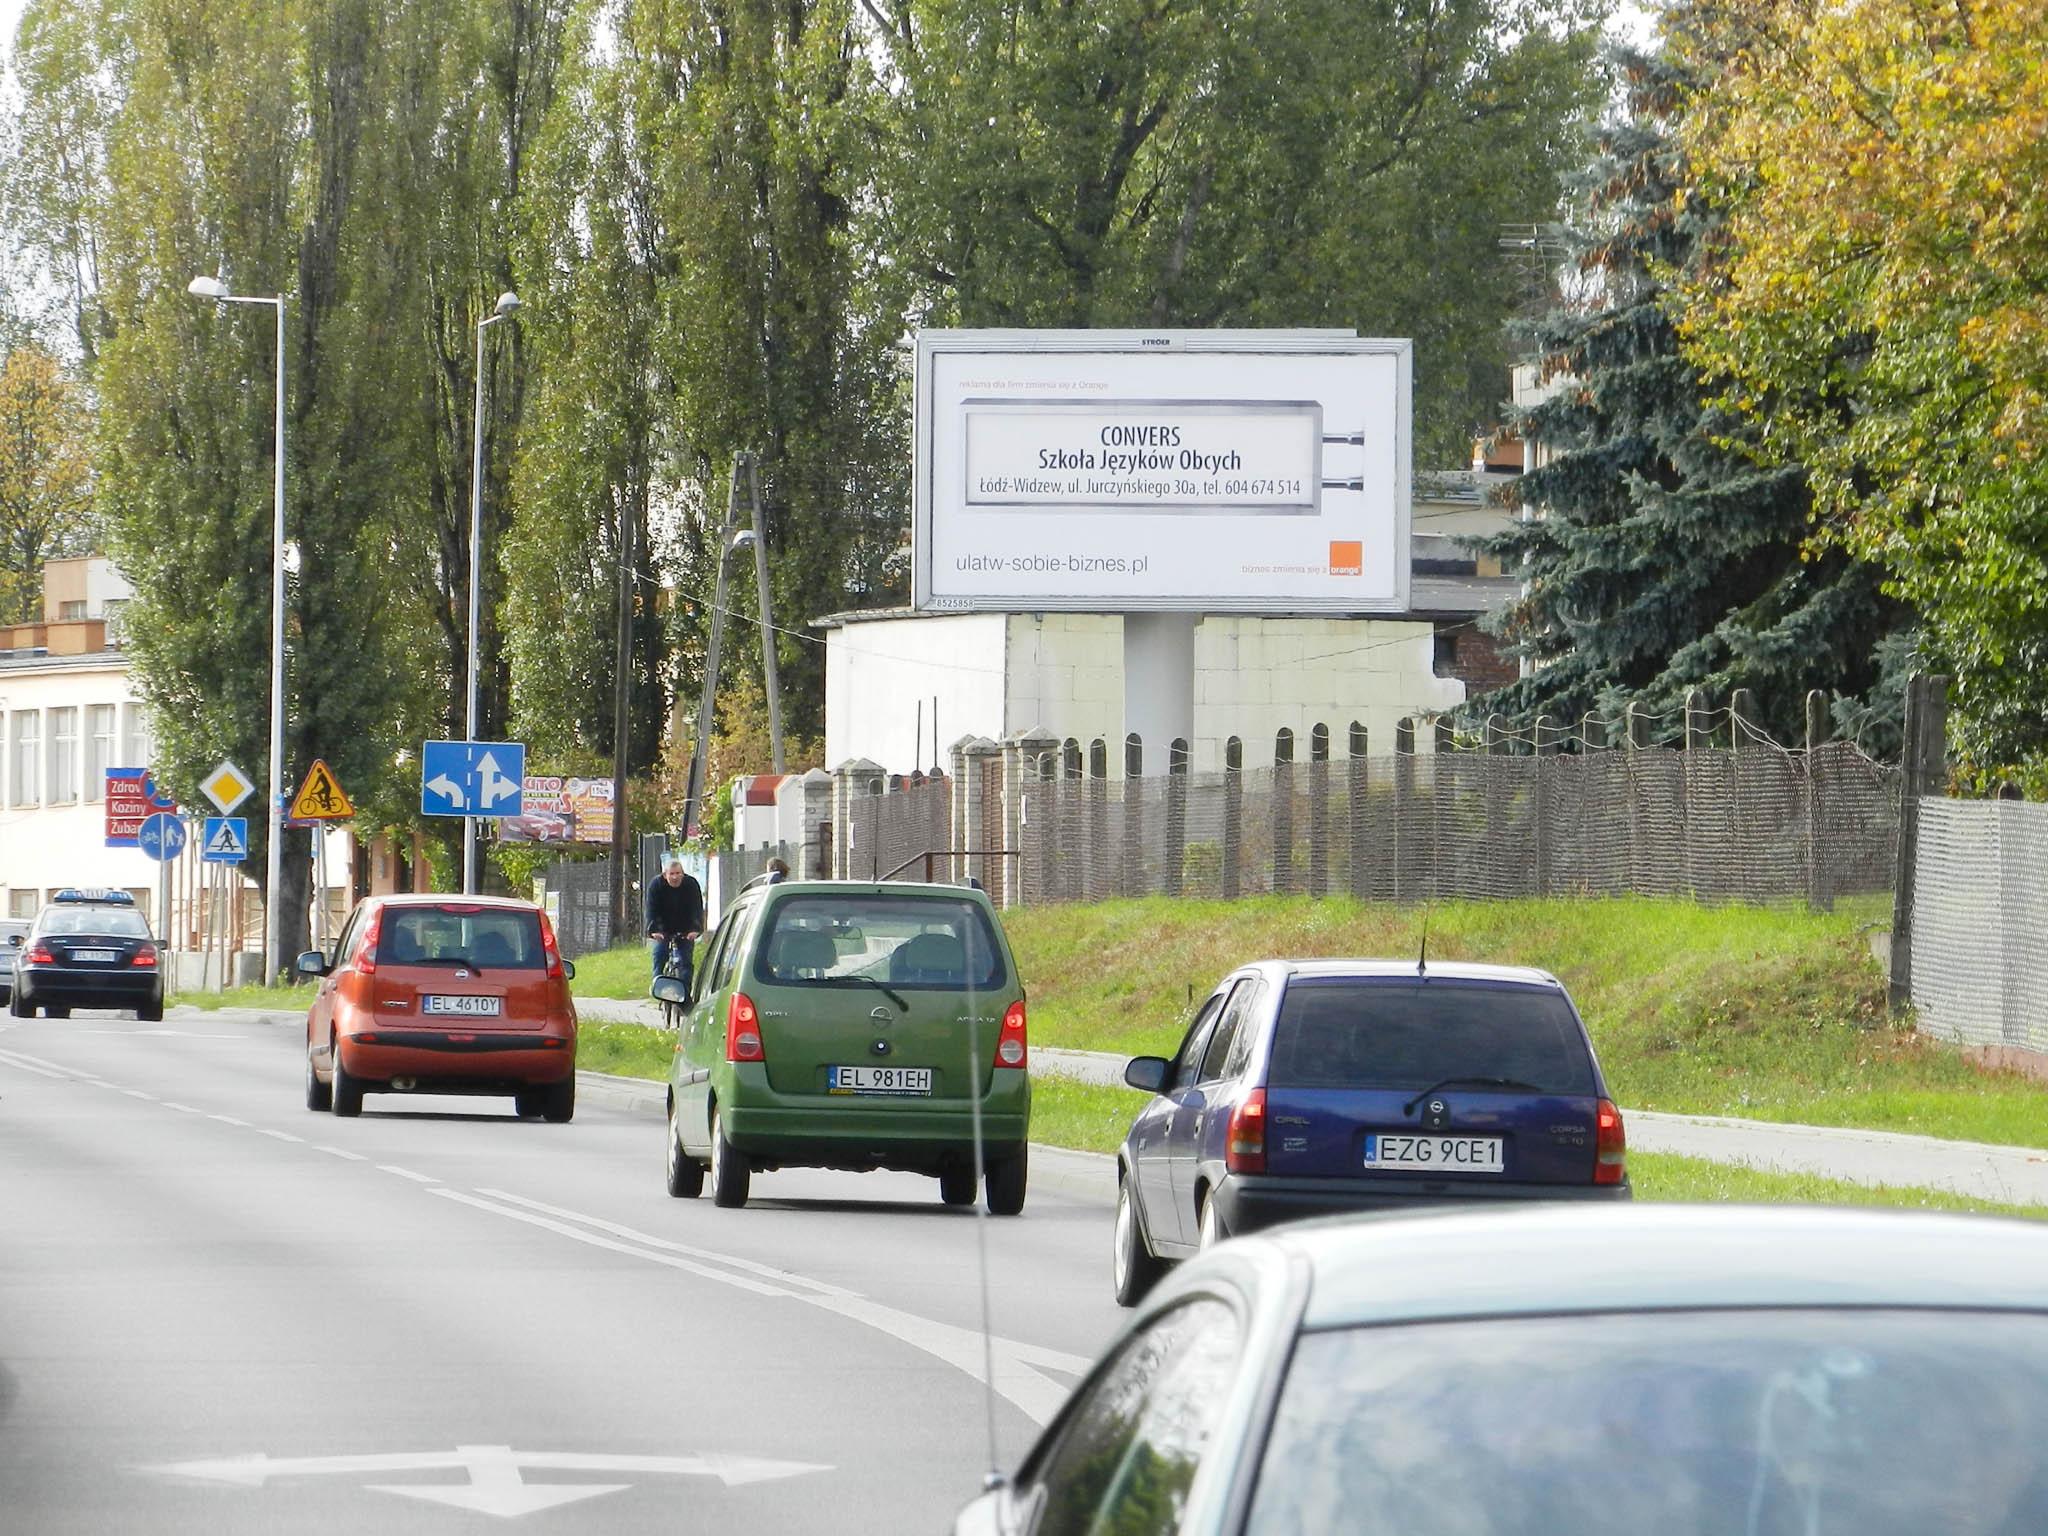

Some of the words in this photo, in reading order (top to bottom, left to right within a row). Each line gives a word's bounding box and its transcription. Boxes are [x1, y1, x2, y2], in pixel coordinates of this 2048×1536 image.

[1101, 425, 1181, 447] CONVERS
[1039, 448, 1095, 470] Szkoła
[1100, 449, 1174, 476] Języków
[1179, 449, 1242, 476] Obcych
[979, 476, 1064, 495] Łódź-Widzew,
[1068, 477, 1082, 494] ul.
[1086, 478, 1170, 498] Jurczyńskiego
[1174, 479, 1200, 497] 30a,
[1203, 480, 1222, 495] tel.
[1225, 479, 1248, 495] 604
[1251, 479, 1274, 495] 674
[1277, 480, 1301, 495] 514
[955, 553, 1149, 576] ulatw-sobie-biznes.pl
[936, 599, 974, 608] 8525858
[111, 800, 147, 816] Koziny
[432, 997, 451, 1011] EL
[456, 998, 497, 1012] 4610Y
[840, 1069, 865, 1087] EL
[872, 1069, 928, 1088] 981EH
[1381, 1138, 1432, 1162] EZG
[1440, 1139, 1496, 1163] 9CE1
